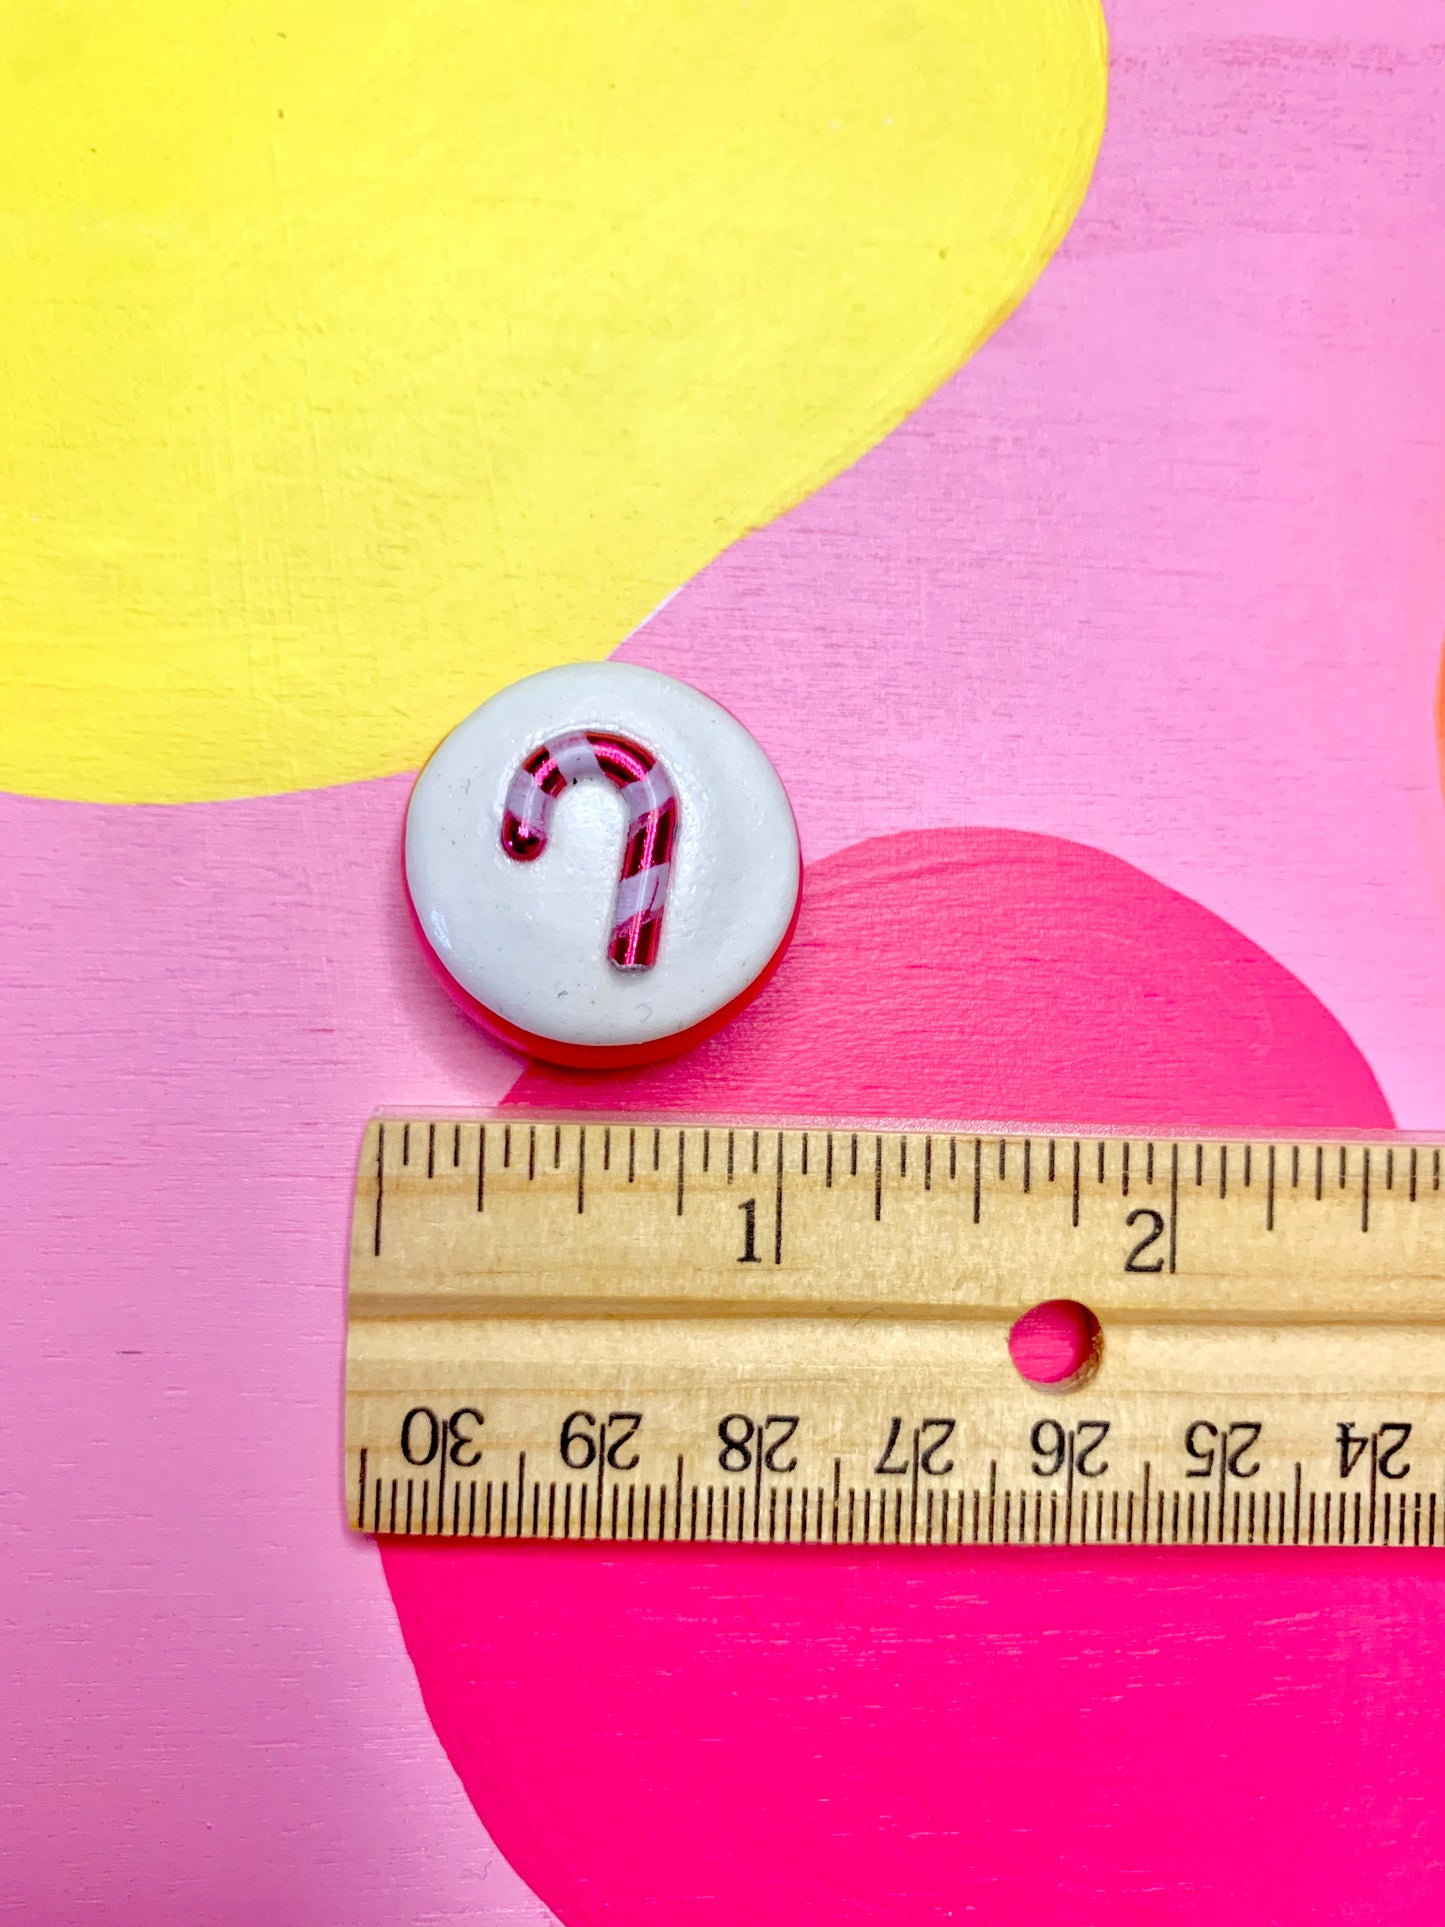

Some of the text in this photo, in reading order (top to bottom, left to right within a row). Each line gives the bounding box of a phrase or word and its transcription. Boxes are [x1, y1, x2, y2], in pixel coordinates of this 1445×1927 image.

[736, 1198, 1165, 1273] 1 2
[400, 1406, 1412, 1480] 24 25 26 27 28 29 30
